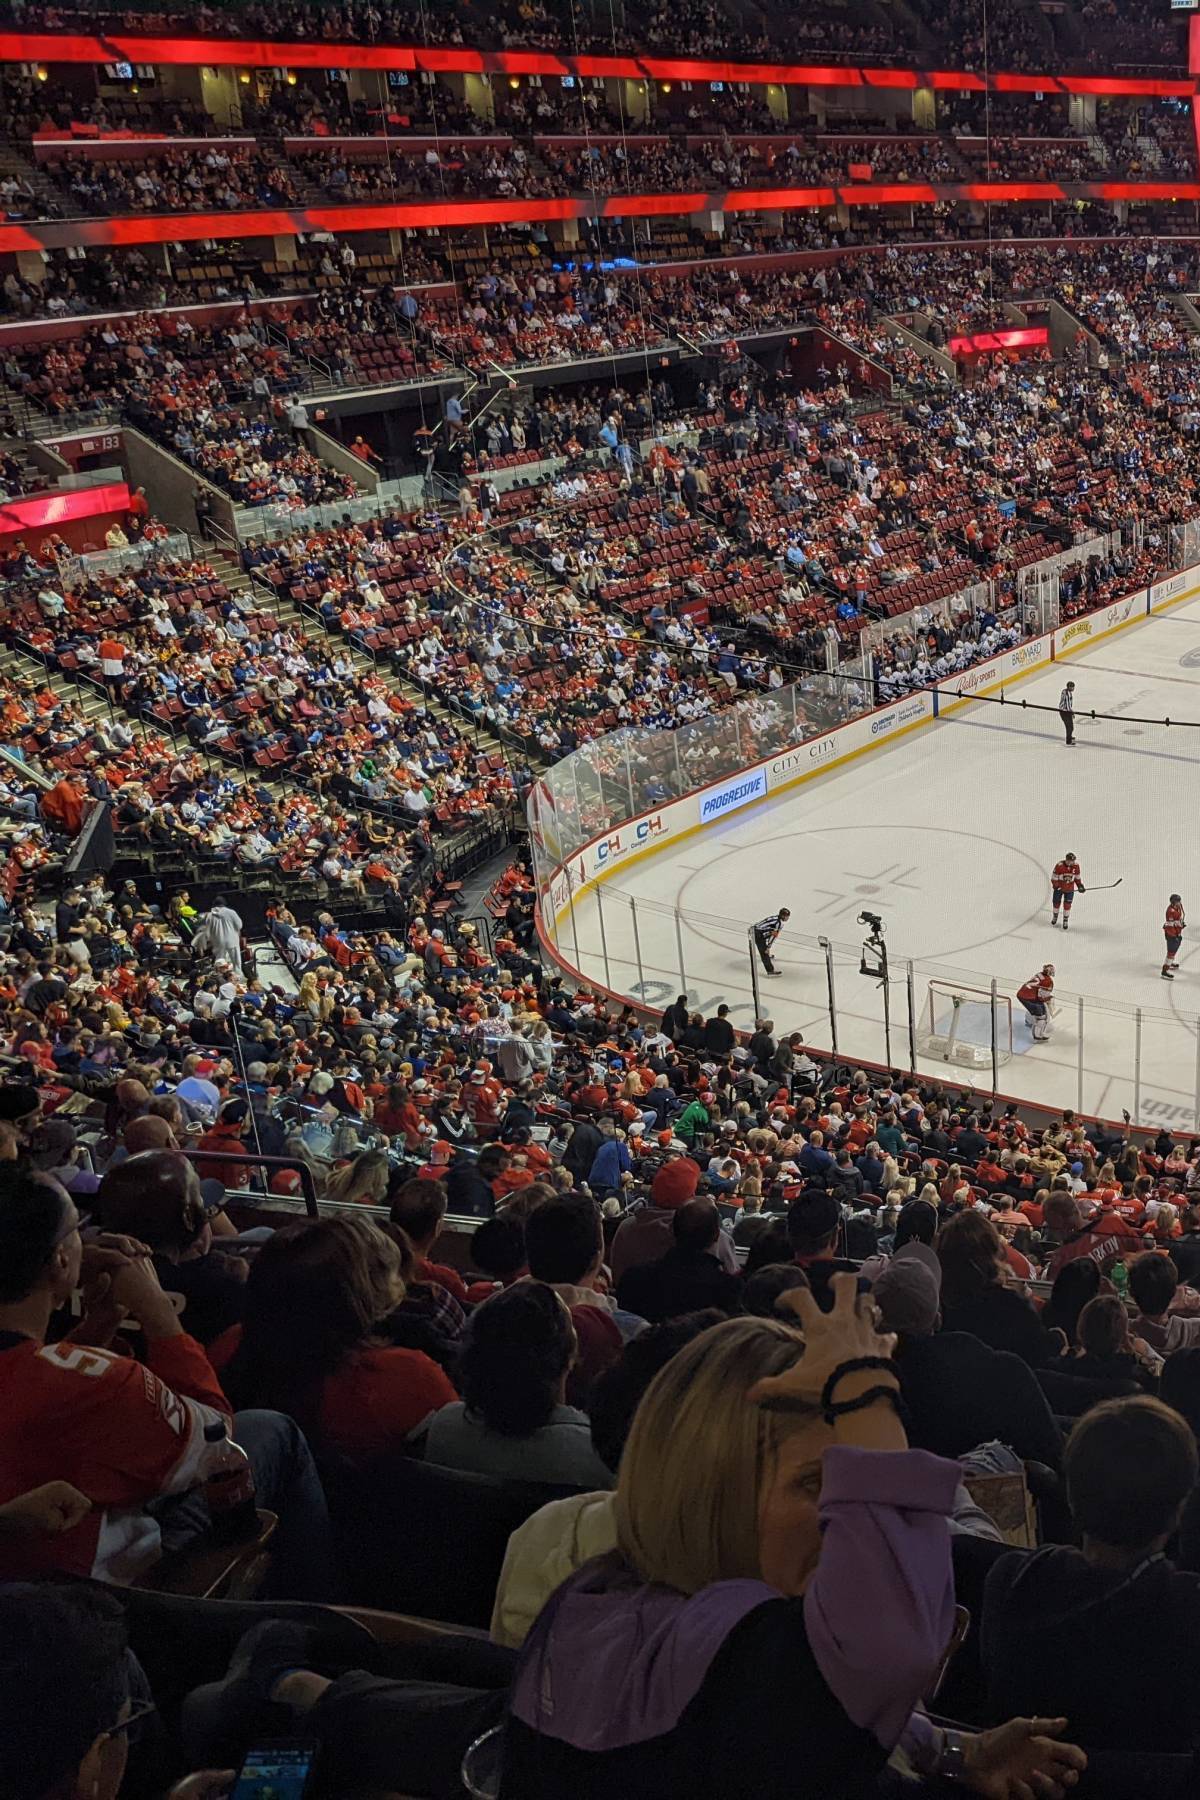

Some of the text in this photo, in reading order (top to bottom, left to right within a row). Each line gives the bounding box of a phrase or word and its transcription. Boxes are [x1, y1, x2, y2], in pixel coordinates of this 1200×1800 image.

[102, 436, 119, 449] 133
[956, 668, 996, 693] Bally SPORTS
[809, 737, 837, 758] CITY
[773, 753, 802, 775] CITY
[702, 776, 764, 817] PROGRESSIVE
[637, 815, 661, 840] CH
[598, 835, 621, 860] CH
[1088, 1235, 1119, 1264] ARKOV
